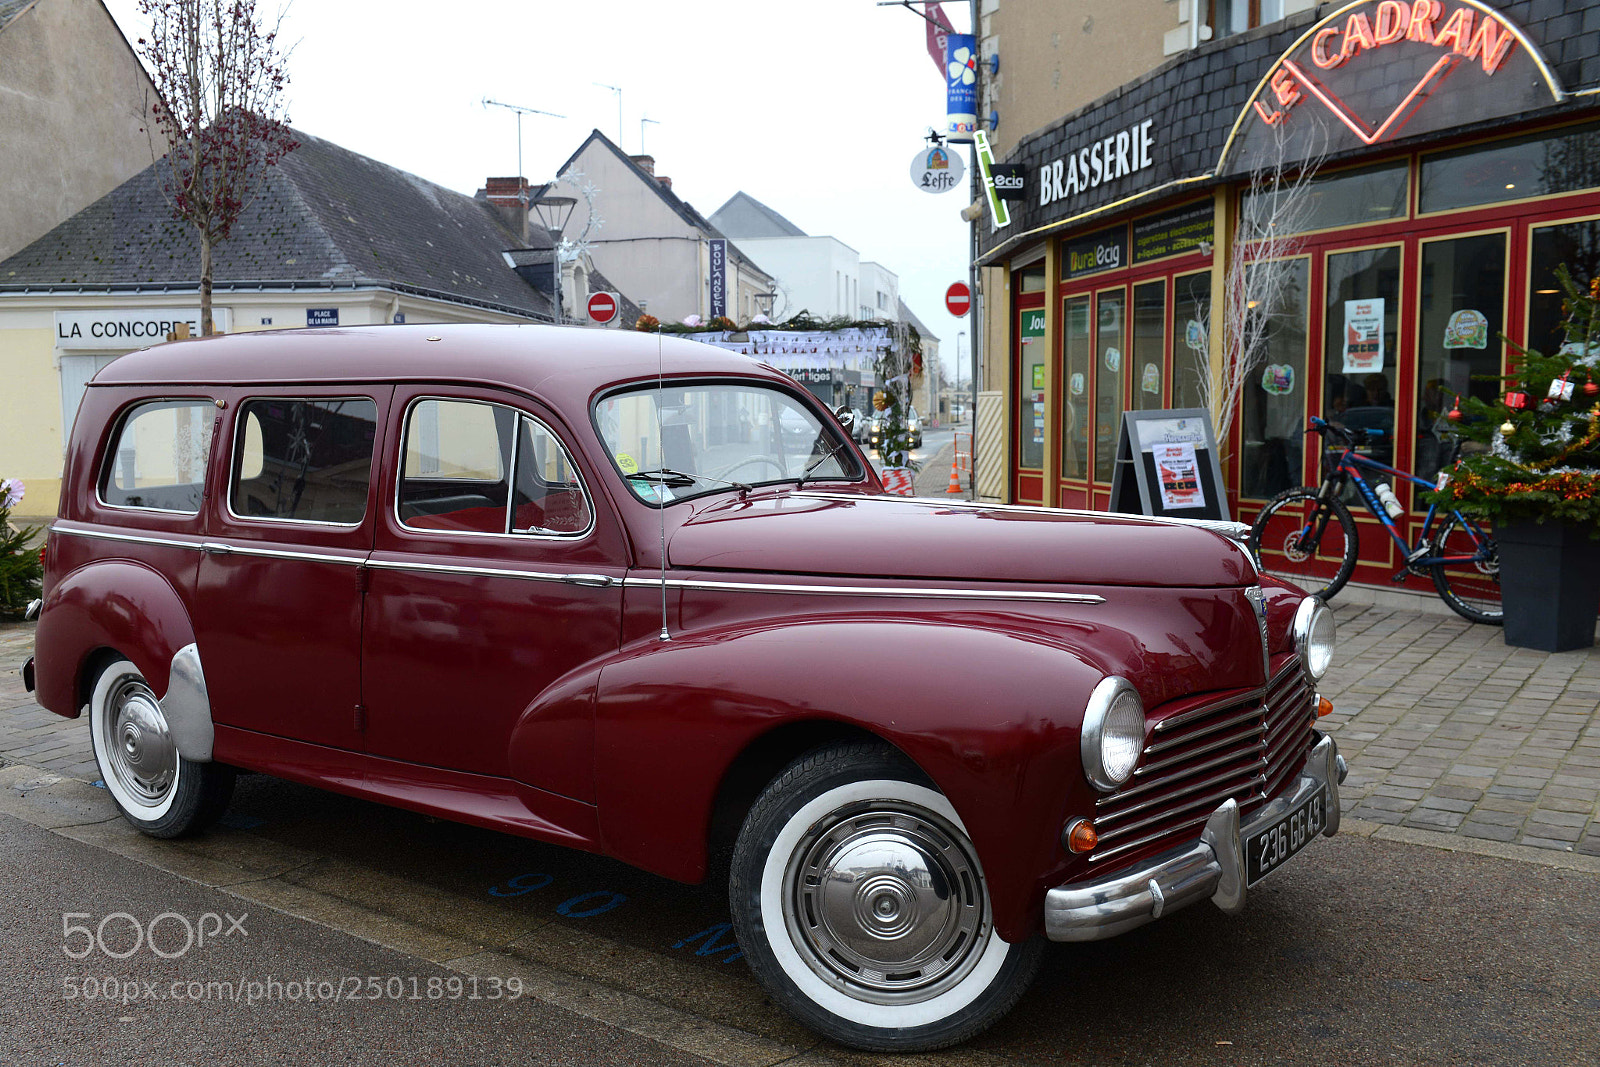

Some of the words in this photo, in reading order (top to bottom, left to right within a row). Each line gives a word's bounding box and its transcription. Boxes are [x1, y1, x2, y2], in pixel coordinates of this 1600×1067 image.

[1253, 69, 1301, 128] LE
[1312, 0, 1516, 77] CADRAN
[921, 171, 955, 190] Leffe
[995, 169, 1024, 189] ecig
[1040, 119, 1153, 206] BRASSERIE
[58, 322, 82, 338] LA
[91, 320, 197, 339] CONCORE
[1260, 822, 1287, 872] 236
[1290, 808, 1305, 851] GG
[1307, 796, 1320, 835] 49
